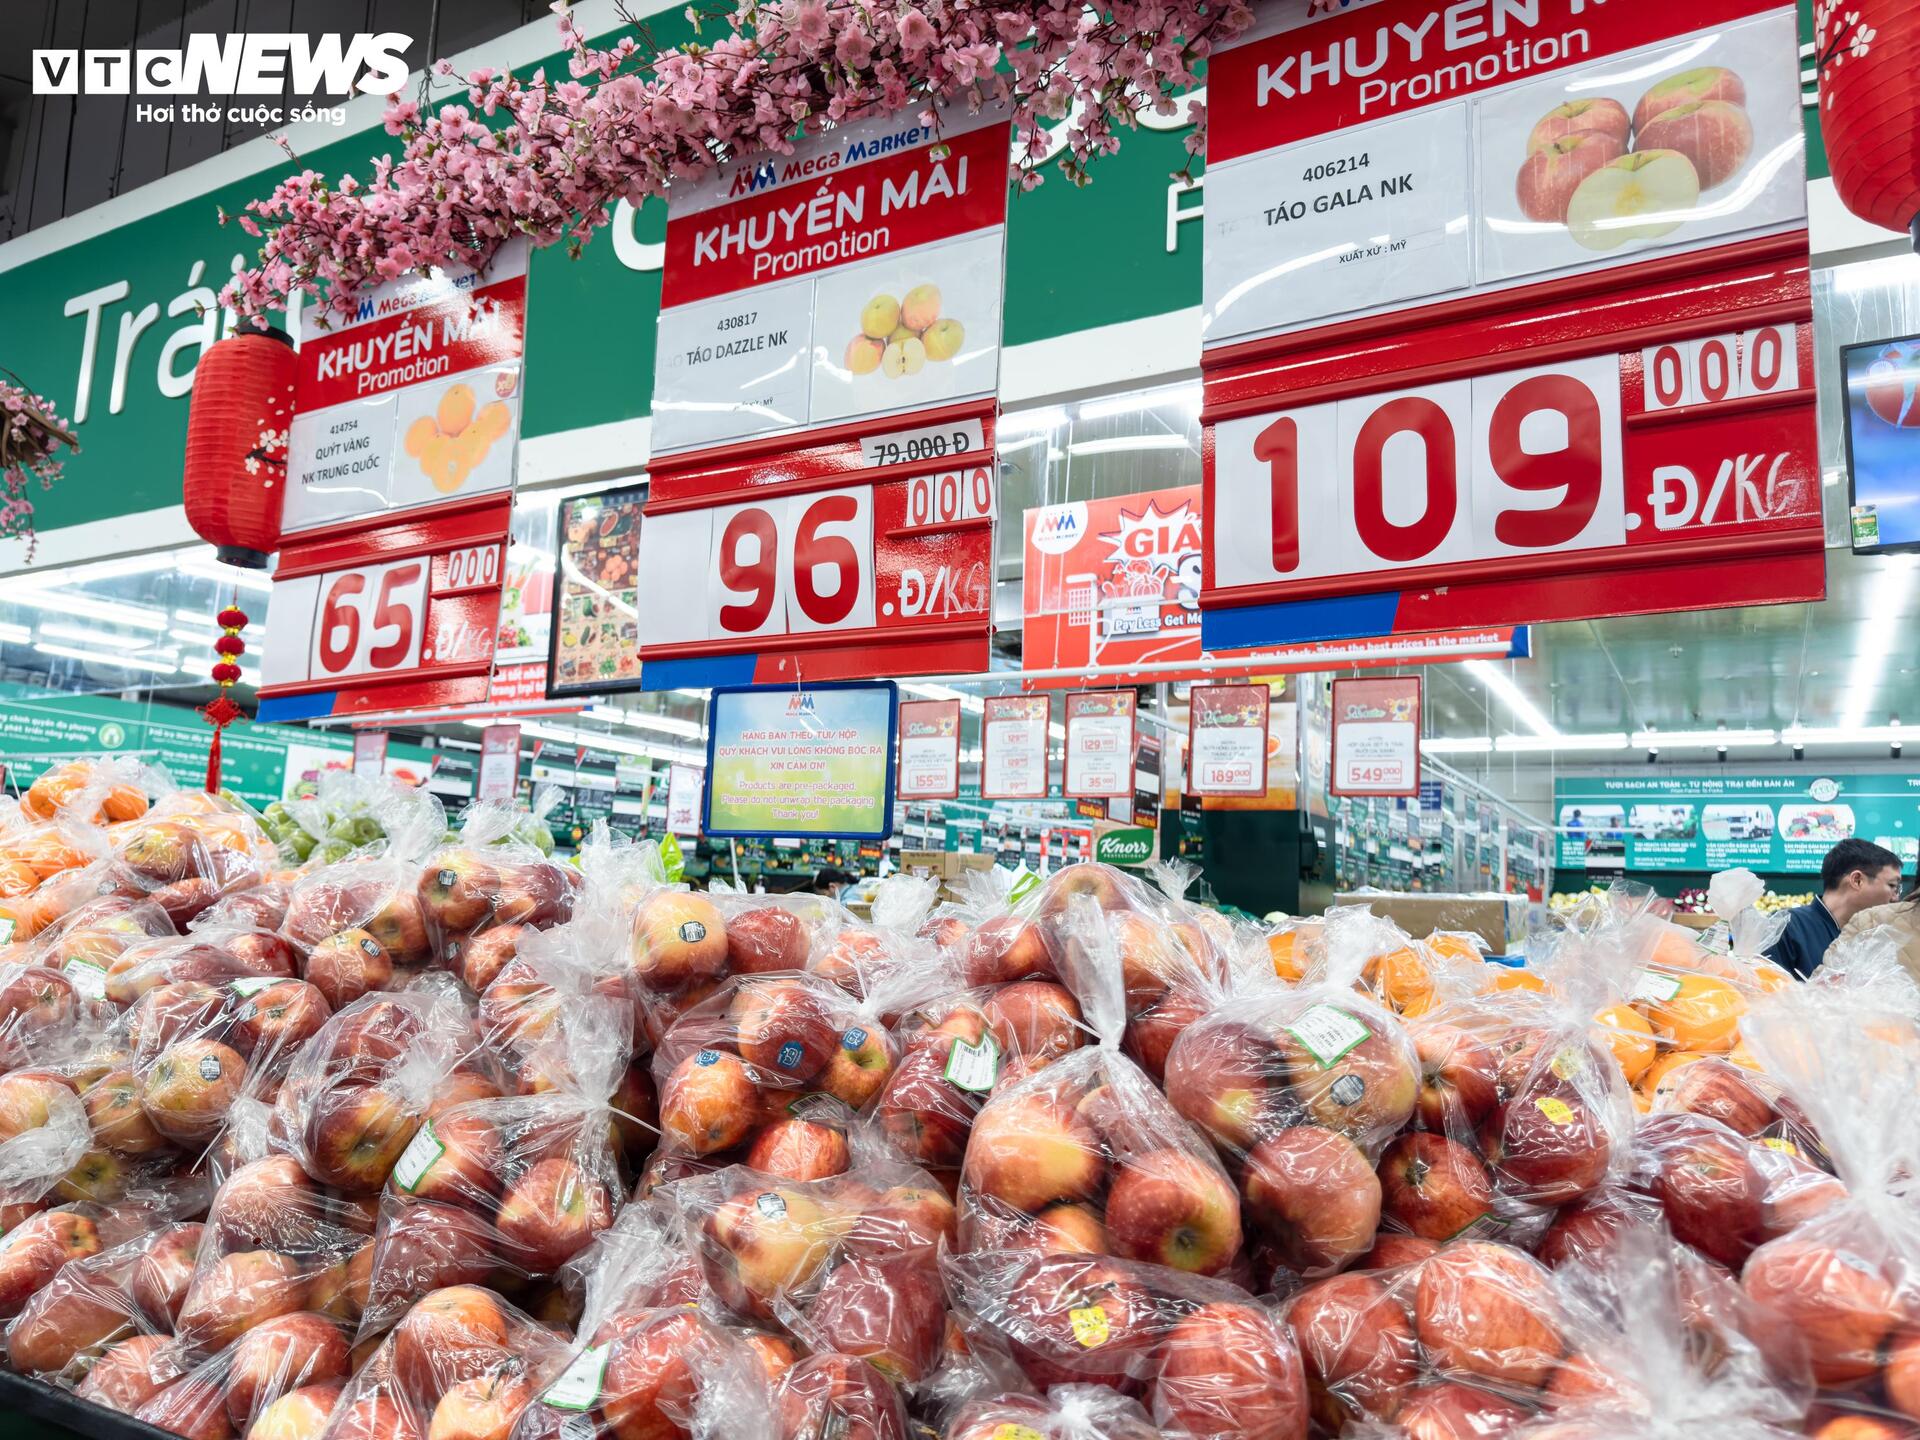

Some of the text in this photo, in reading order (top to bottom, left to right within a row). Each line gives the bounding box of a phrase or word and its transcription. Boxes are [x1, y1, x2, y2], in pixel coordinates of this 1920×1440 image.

[1359, 28, 1590, 115] Promotion
[1303, 152, 1370, 182] 406214
[1264, 173, 1413, 226] TÁO GALA NK
[693, 177, 865, 267] KHUYẾN
[753, 226, 890, 280] Promotion
[1339, 250, 1364, 264] XUẤT
[1390, 240, 1407, 252] MỸ
[717, 312, 757, 331] 430817
[317, 312, 433, 382] KHUYẾN
[687, 330, 788, 366] TÁO DAZZLE NK
[357, 354, 449, 394] Promotion
[1653, 327, 1783, 407] 000
[330, 419, 358, 435] 414754
[315, 436, 370, 460] QUÝT VÀNG
[873, 431, 970, 467] 79.000 Đ
[302, 454, 380, 485] NK TRUNG QUỐC
[1253, 373, 1602, 573] 109
[912, 468, 991, 525] 000
[448, 543, 496, 588] 000
[719, 495, 861, 633] 96
[319, 563, 422, 673] 65
[1114, 618, 1136, 633] Pay
[1137, 615, 1161, 630] Less
[1164, 614, 1184, 627] Get
[1439, 636, 1457, 646] the
[1459, 633, 1499, 643] market
[770, 762, 785, 770] XIN
[915, 775, 934, 787] 155
[1211, 768, 1234, 782] 189
[1351, 767, 1383, 781] 549
[739, 780, 776, 790] Products
[779, 782, 792, 790] are
[721, 795, 874, 807] Please do not unwrap the packaging
[772, 808, 799, 819] Thank
[1100, 836, 1149, 854] Knorr
